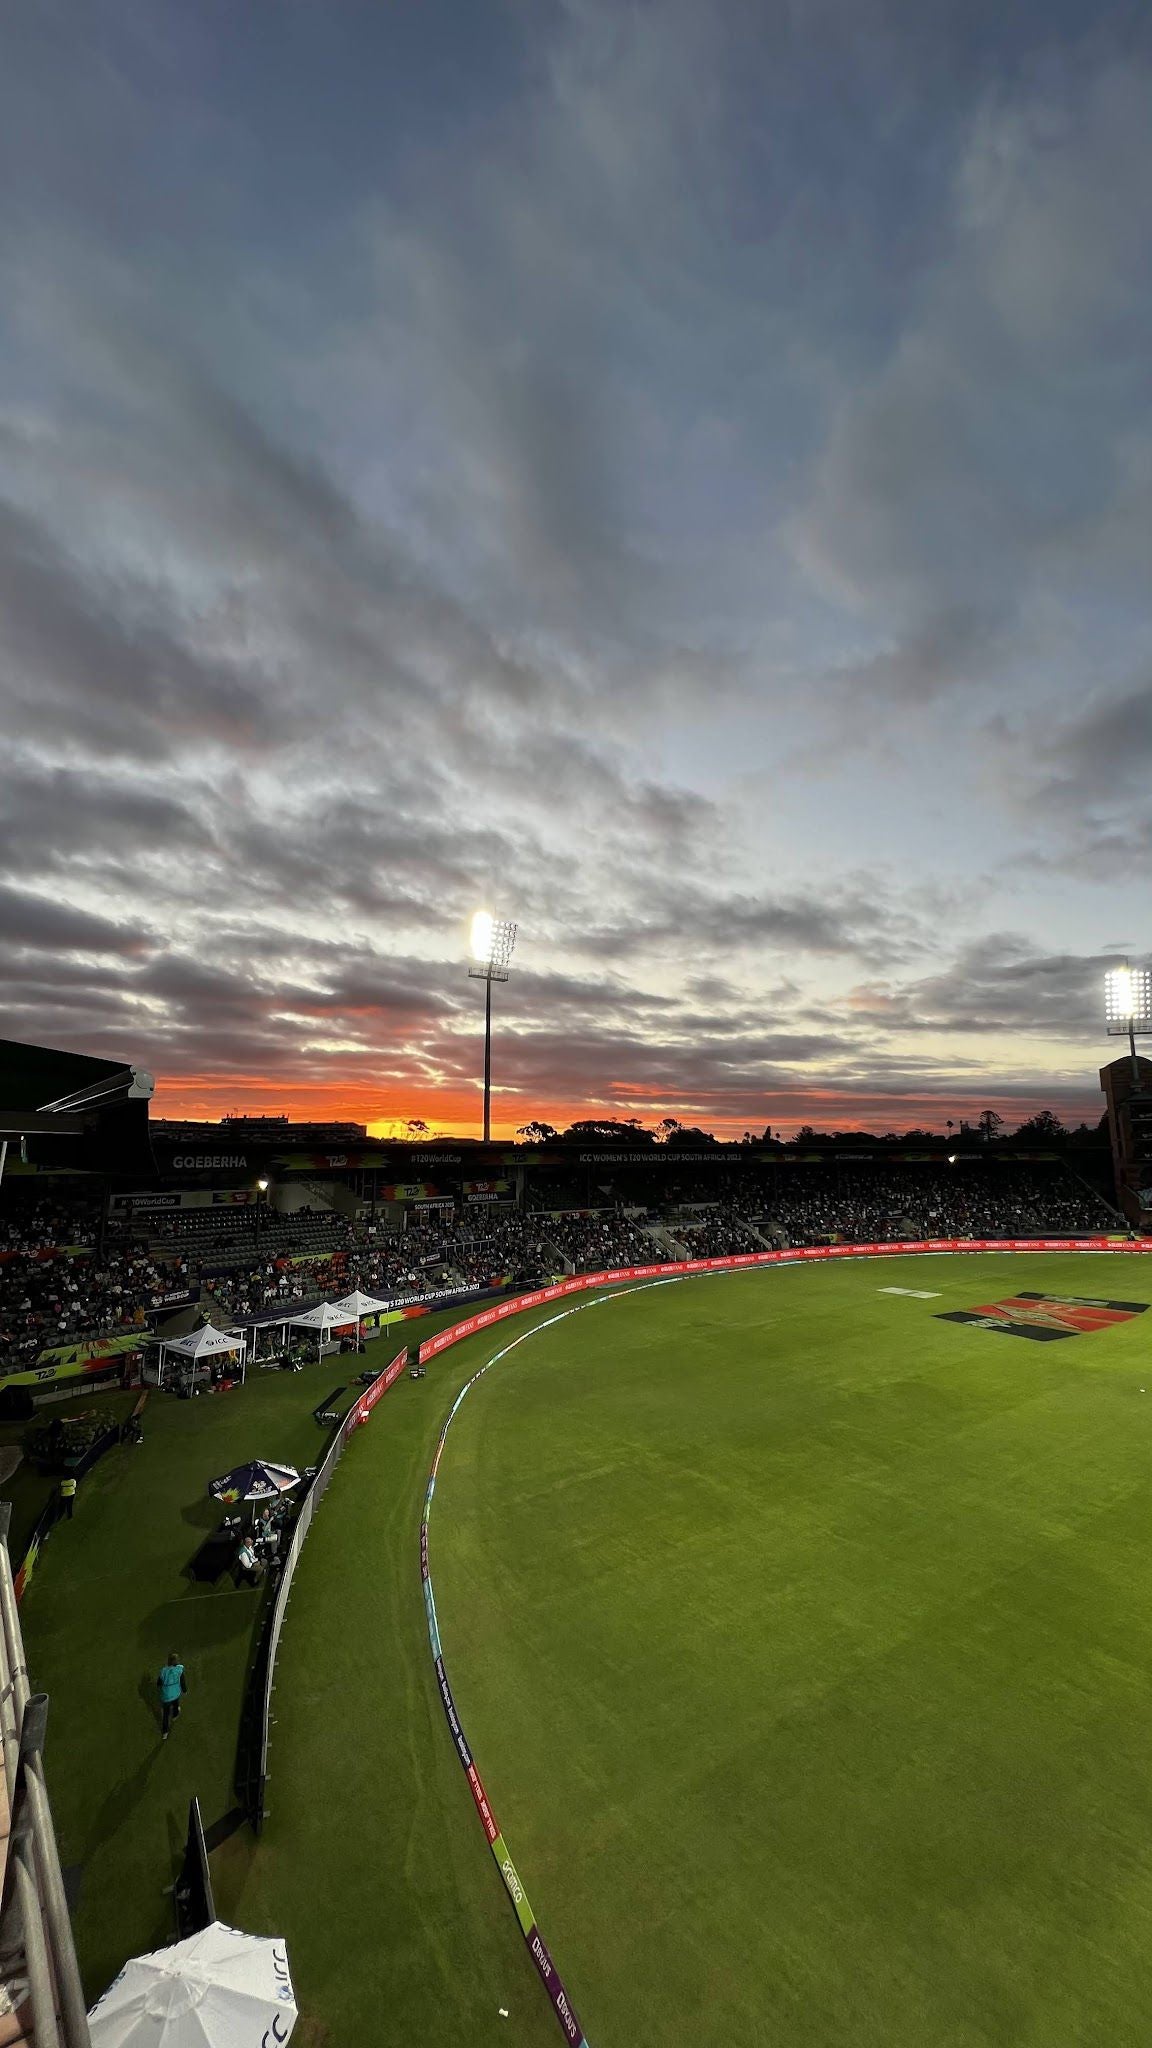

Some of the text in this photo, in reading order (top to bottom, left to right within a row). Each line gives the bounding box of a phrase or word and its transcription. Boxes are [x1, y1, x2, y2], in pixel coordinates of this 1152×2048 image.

[172, 1155, 247, 1168] GQEBERHA
[411, 1153, 461, 1164] #T20WorldCup
[580, 1154, 592, 1162] ICC
[593, 1154, 628, 1162] WOMEN'S
[629, 1154, 640, 1162] T20
[641, 1153, 666, 1161] WORLD
[667, 1153, 680, 1161] CUP
[122, 1197, 176, 1206] #0WorldCup
[405, 1294, 424, 1304] WORLD
[424, 1291, 435, 1301] CUP
[435, 1288, 452, 1298] SOUTH
[452, 1285, 469, 1295] AFRICA
[502, 1860, 522, 1903] aramco
